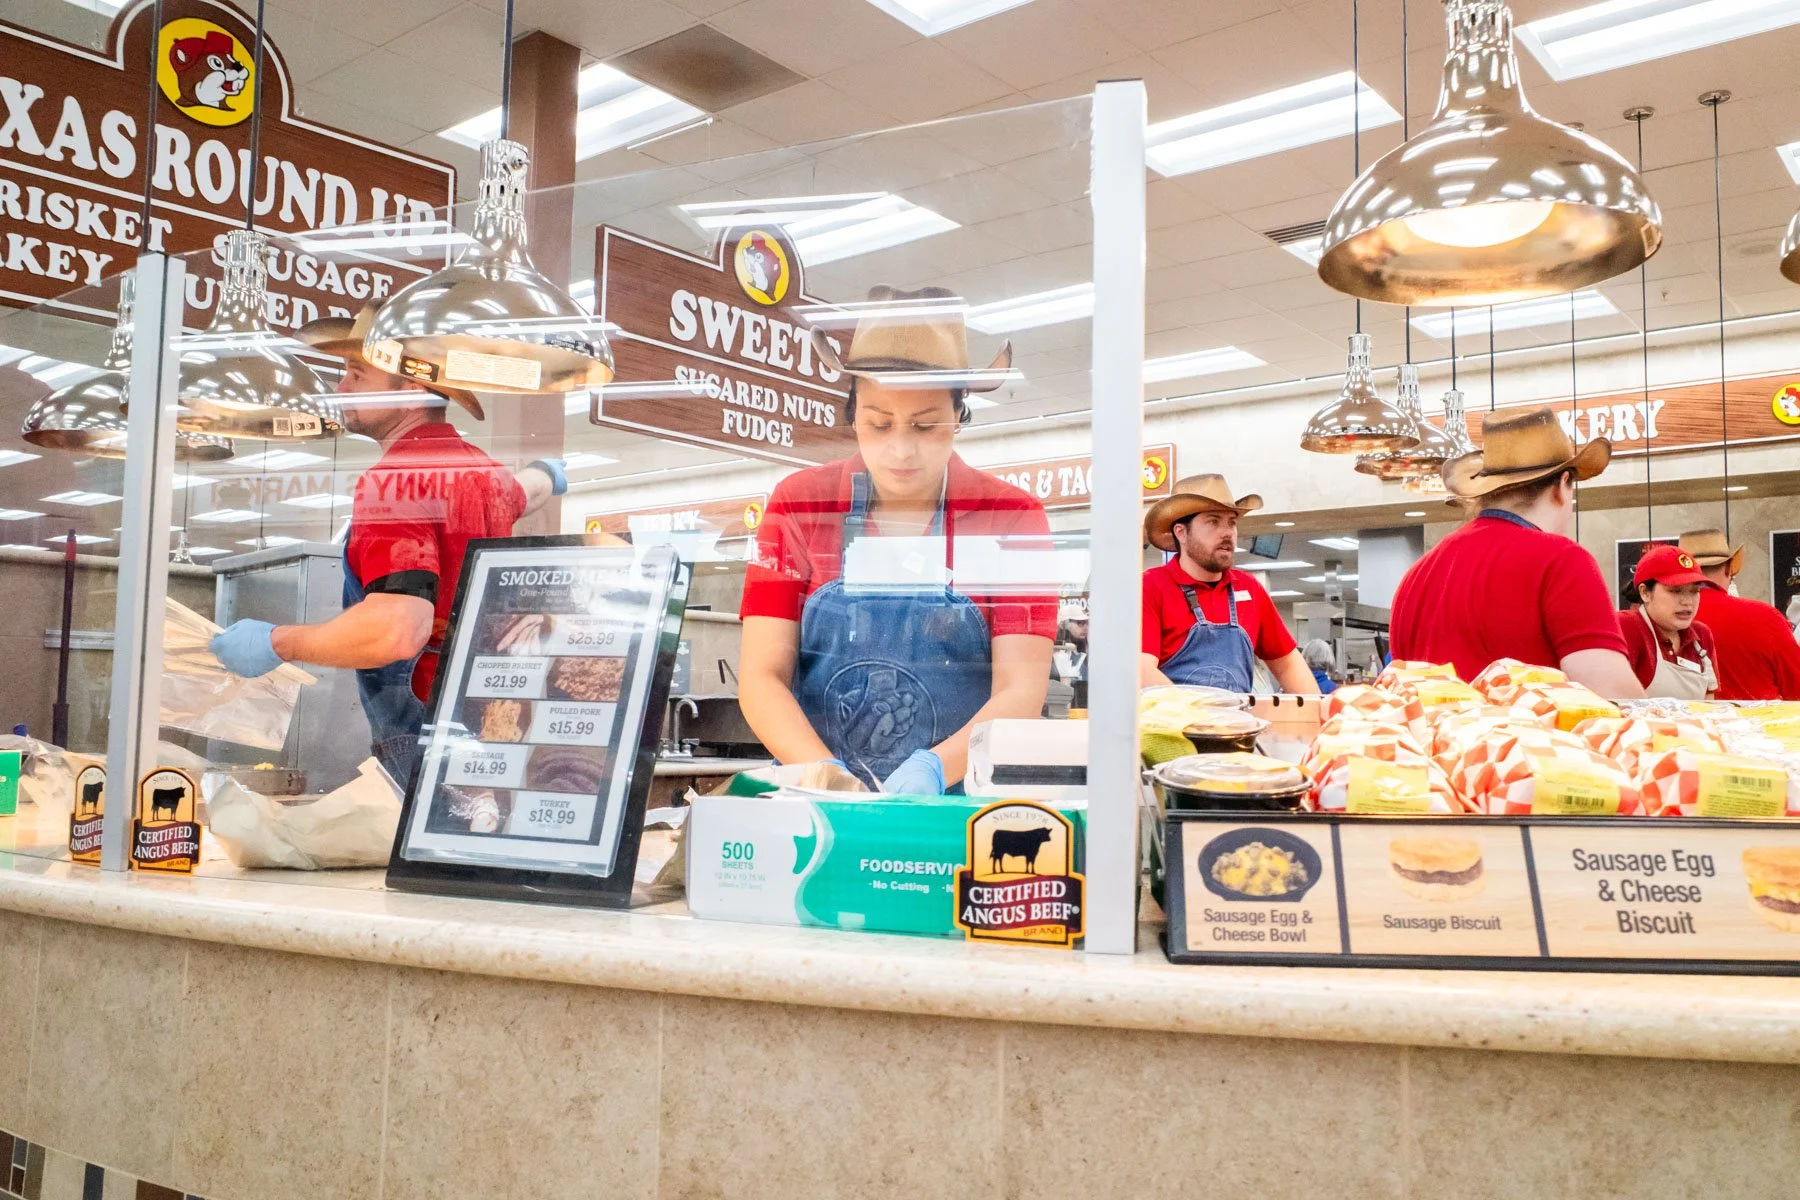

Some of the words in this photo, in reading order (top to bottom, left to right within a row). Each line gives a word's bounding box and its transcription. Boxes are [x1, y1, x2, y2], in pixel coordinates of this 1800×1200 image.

[0, 76, 137, 179] XAS
[152, 123, 358, 237] ROUND
[371, 187, 436, 256] UP
[0, 179, 173, 252] RISKET
[0, 232, 113, 288] KEY
[210, 233, 393, 302] SUSAGE
[670, 289, 842, 383] SWEETS
[674, 365, 779, 414] SUGARED
[783, 393, 836, 428] NUTS
[721, 407, 794, 448] FUDGE
[1557, 399, 1665, 446] KERY
[1036, 469, 1053, 499] &
[498, 569, 575, 587] SMOKED
[483, 674, 528, 689] $21.99
[549, 706, 579, 715] PULLED
[548, 721, 595, 735] $15.99
[463, 760, 507, 775] $14.99
[539, 799, 571, 808] TURKEY
[528, 808, 576, 825] $18.99
[992, 810, 1022, 824] SINCE
[1024, 811, 1049, 824] 1978
[73, 820, 105, 837] CERTIFIE
[138, 825, 192, 844] CERTIFIED
[70, 837, 93, 851] ANGUS
[133, 844, 169, 859] ANGUS
[722, 841, 754, 860] 500
[721, 860, 754, 870] SHEETS
[1572, 848, 1668, 877] Sausage
[1671, 849, 1716, 877] Egg
[890, 880, 930, 894] Cutting
[968, 880, 1067, 905] CERTIFIED
[1598, 879, 1616, 902] &
[1620, 879, 1703, 903] Cheese
[961, 904, 1027, 925] ANGUS
[1203, 908, 1266, 926] Sausage
[1270, 909, 1298, 927] Egg
[1302, 910, 1314, 924] &
[1383, 914, 1447, 932] Sausage
[1450, 915, 1502, 930] Biscuit
[1616, 910, 1697, 934] Biscuit
[1023, 926, 1063, 937] BRAND
[1212, 926, 1266, 942] Cheese
[1270, 928, 1307, 942] Bowl
